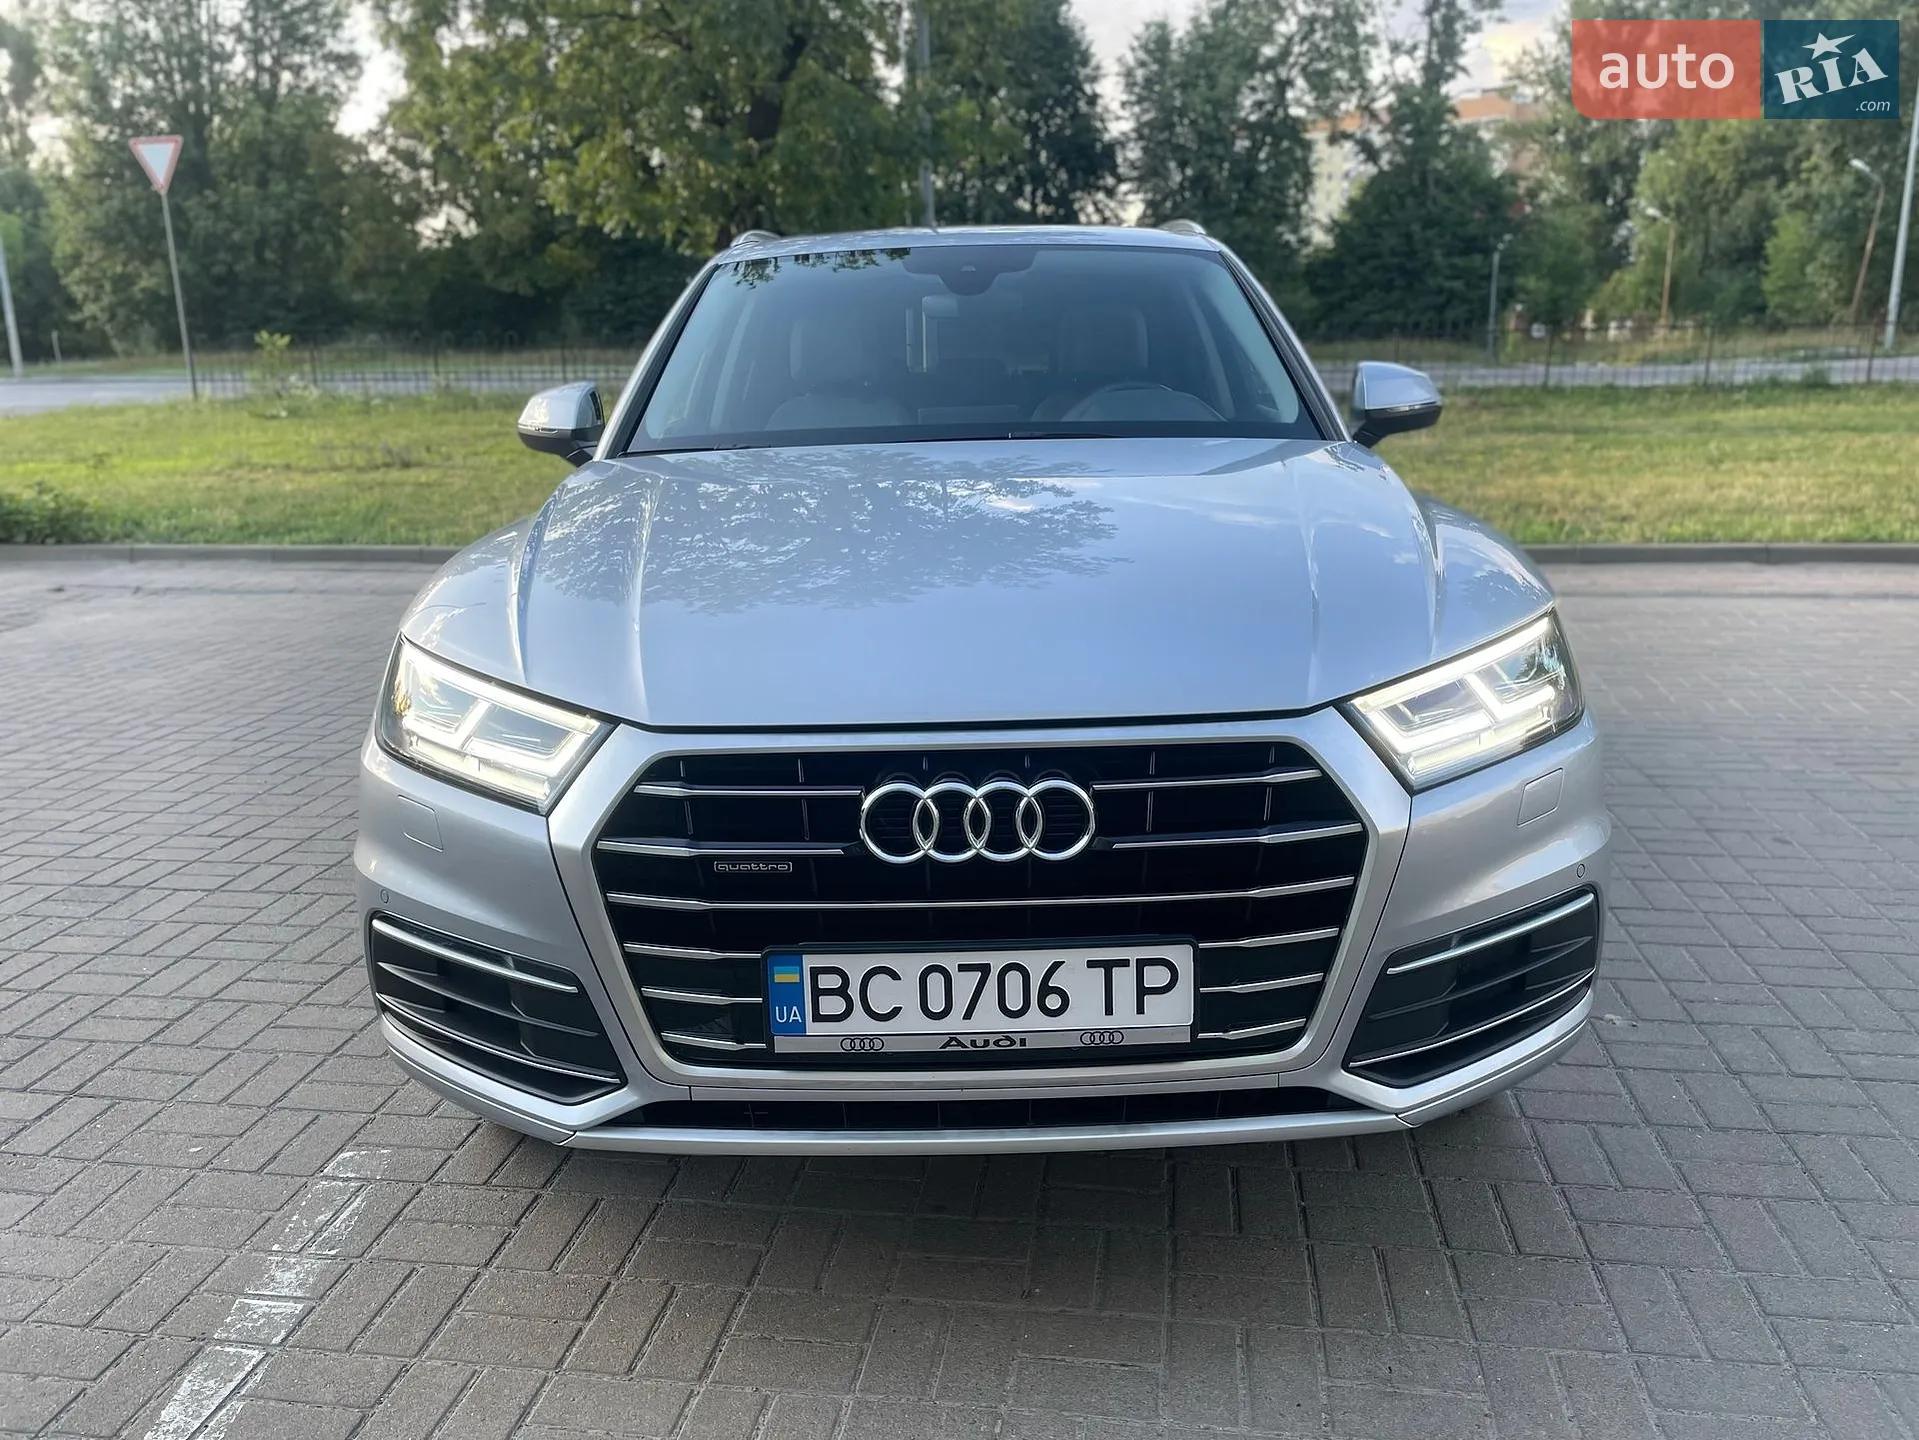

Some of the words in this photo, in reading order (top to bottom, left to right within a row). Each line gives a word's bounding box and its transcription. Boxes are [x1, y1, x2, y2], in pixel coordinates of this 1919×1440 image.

[717, 863, 789, 872] quattro
[808, 965, 903, 1023] BC
[917, 960, 1071, 1021] 0706
[1086, 956, 1179, 1016] TP
[774, 1005, 802, 1023] UA
[938, 1034, 1027, 1050] Audi
